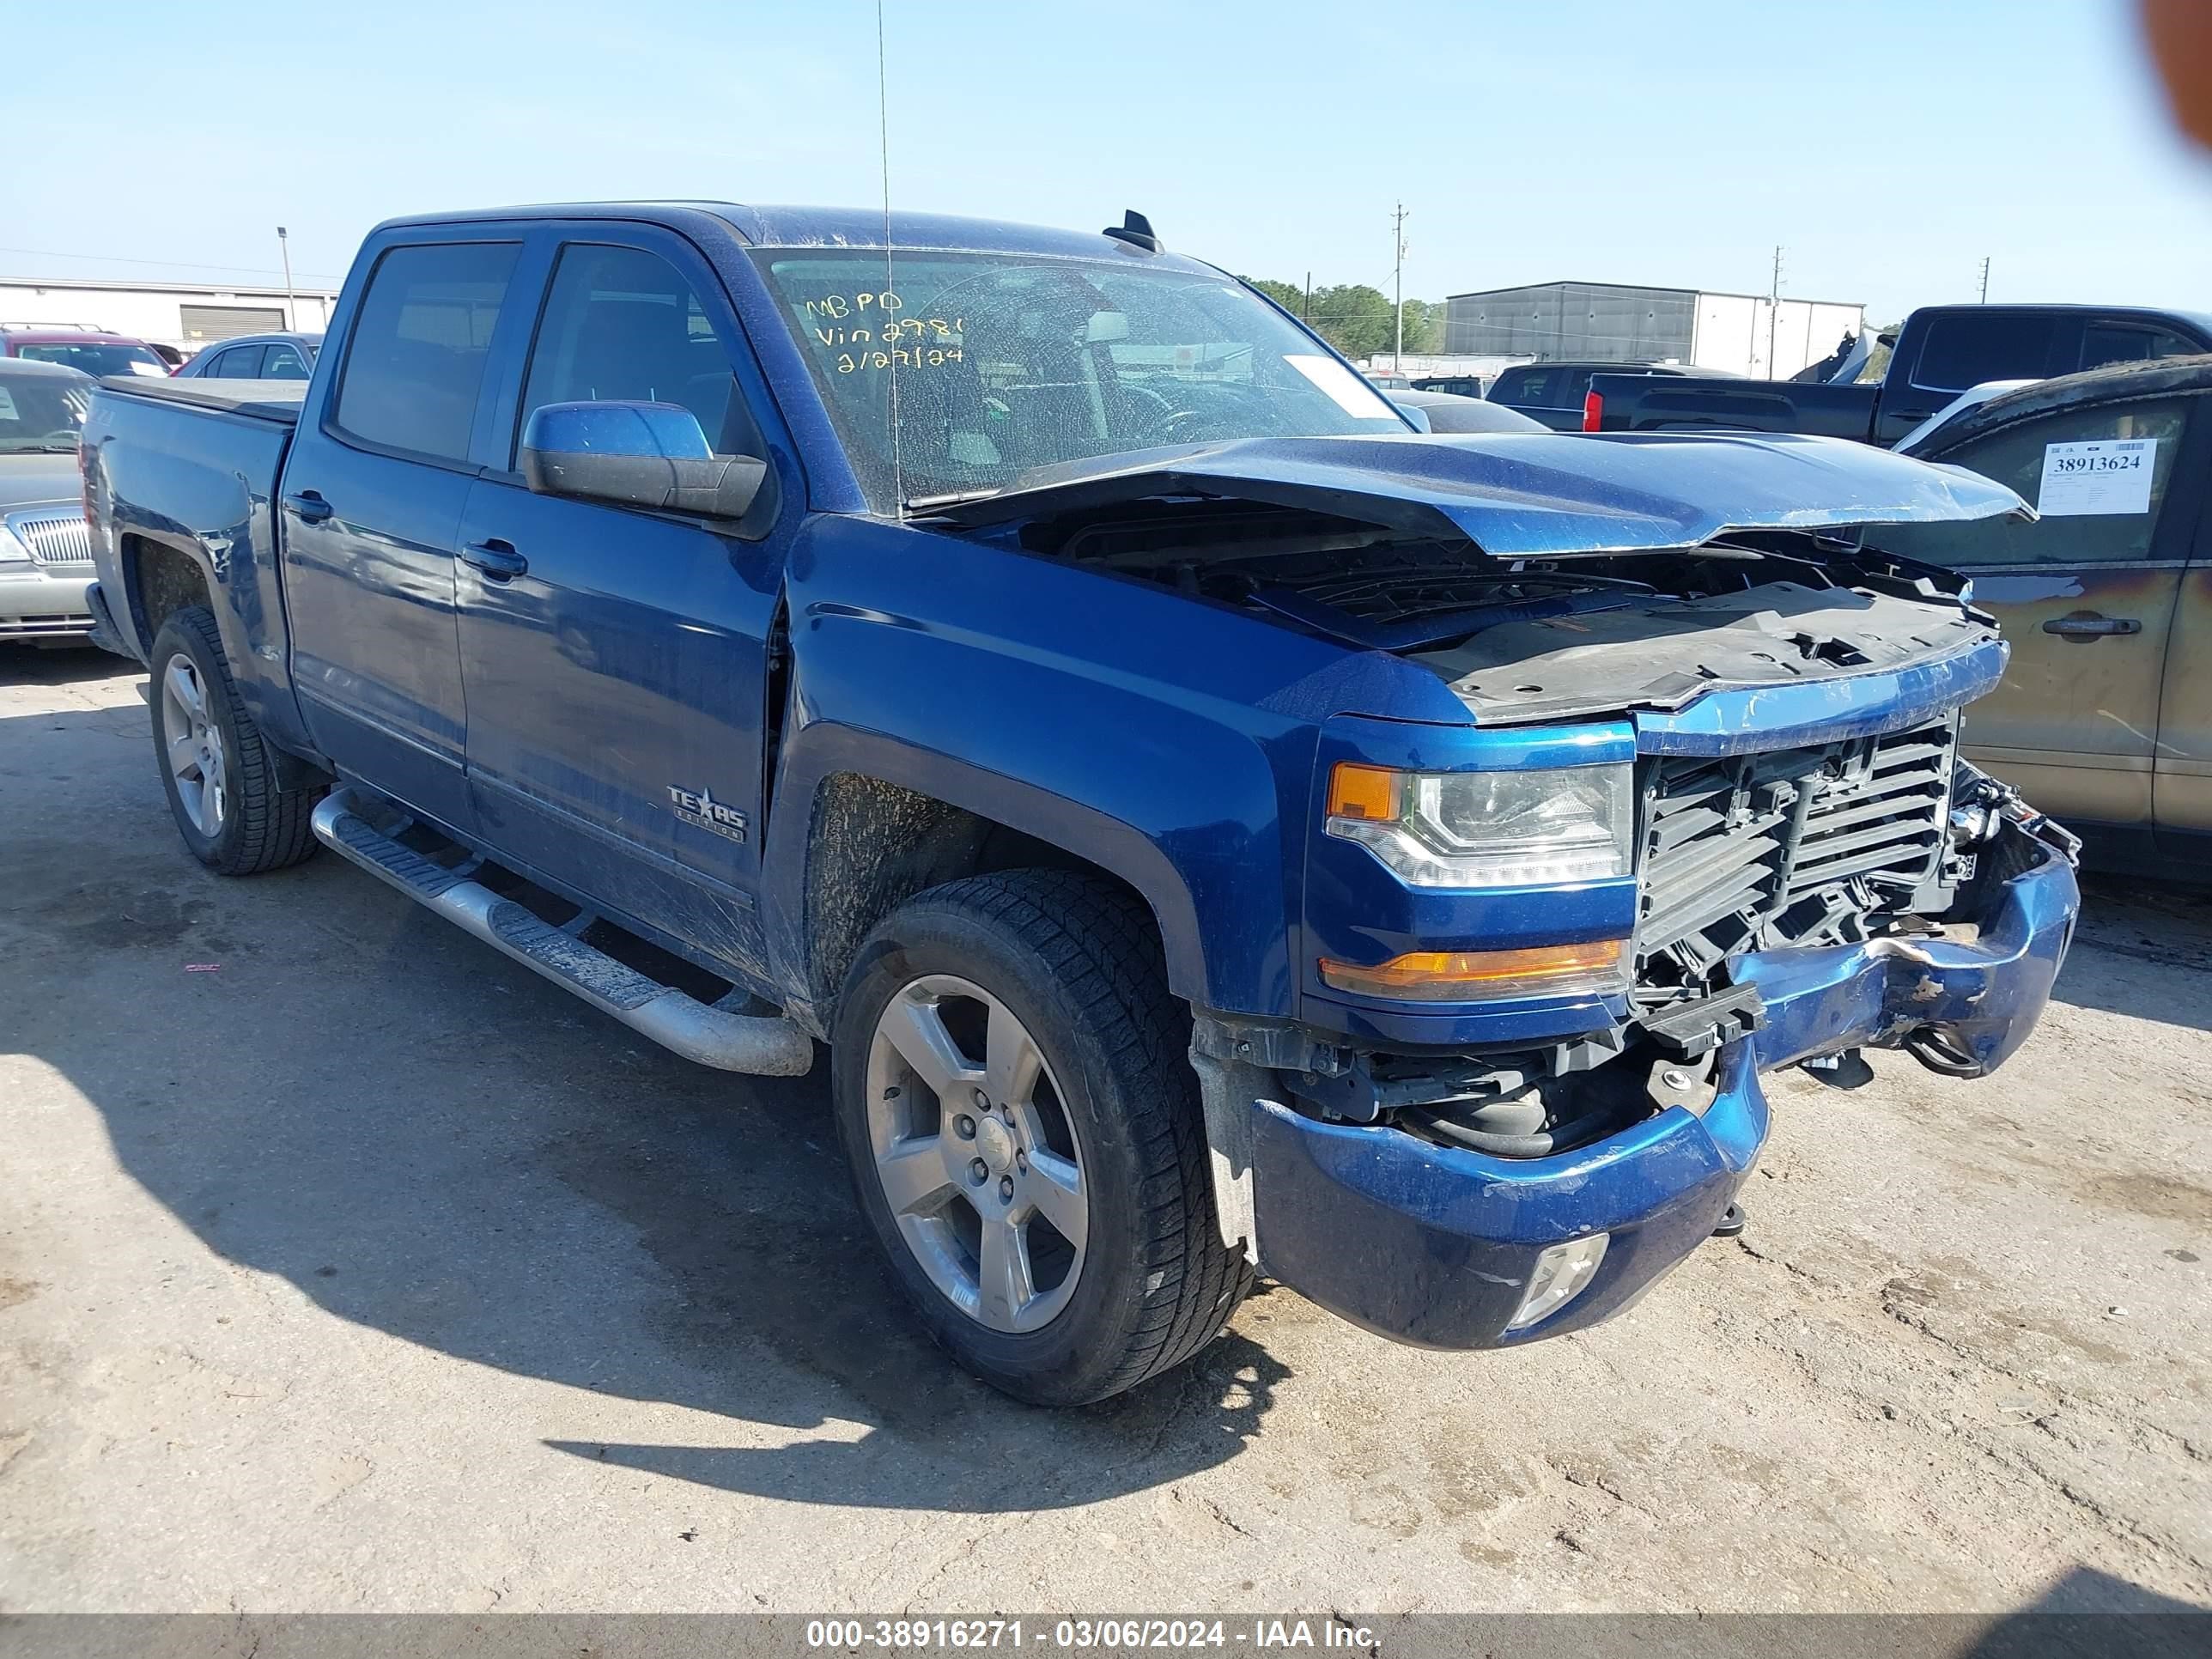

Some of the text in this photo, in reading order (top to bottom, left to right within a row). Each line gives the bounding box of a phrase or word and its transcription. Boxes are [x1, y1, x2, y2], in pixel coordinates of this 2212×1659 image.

[2054, 455, 2141, 472] 38913624
[665, 785, 744, 829] TEXAS
[677, 809, 739, 839] EDITION
